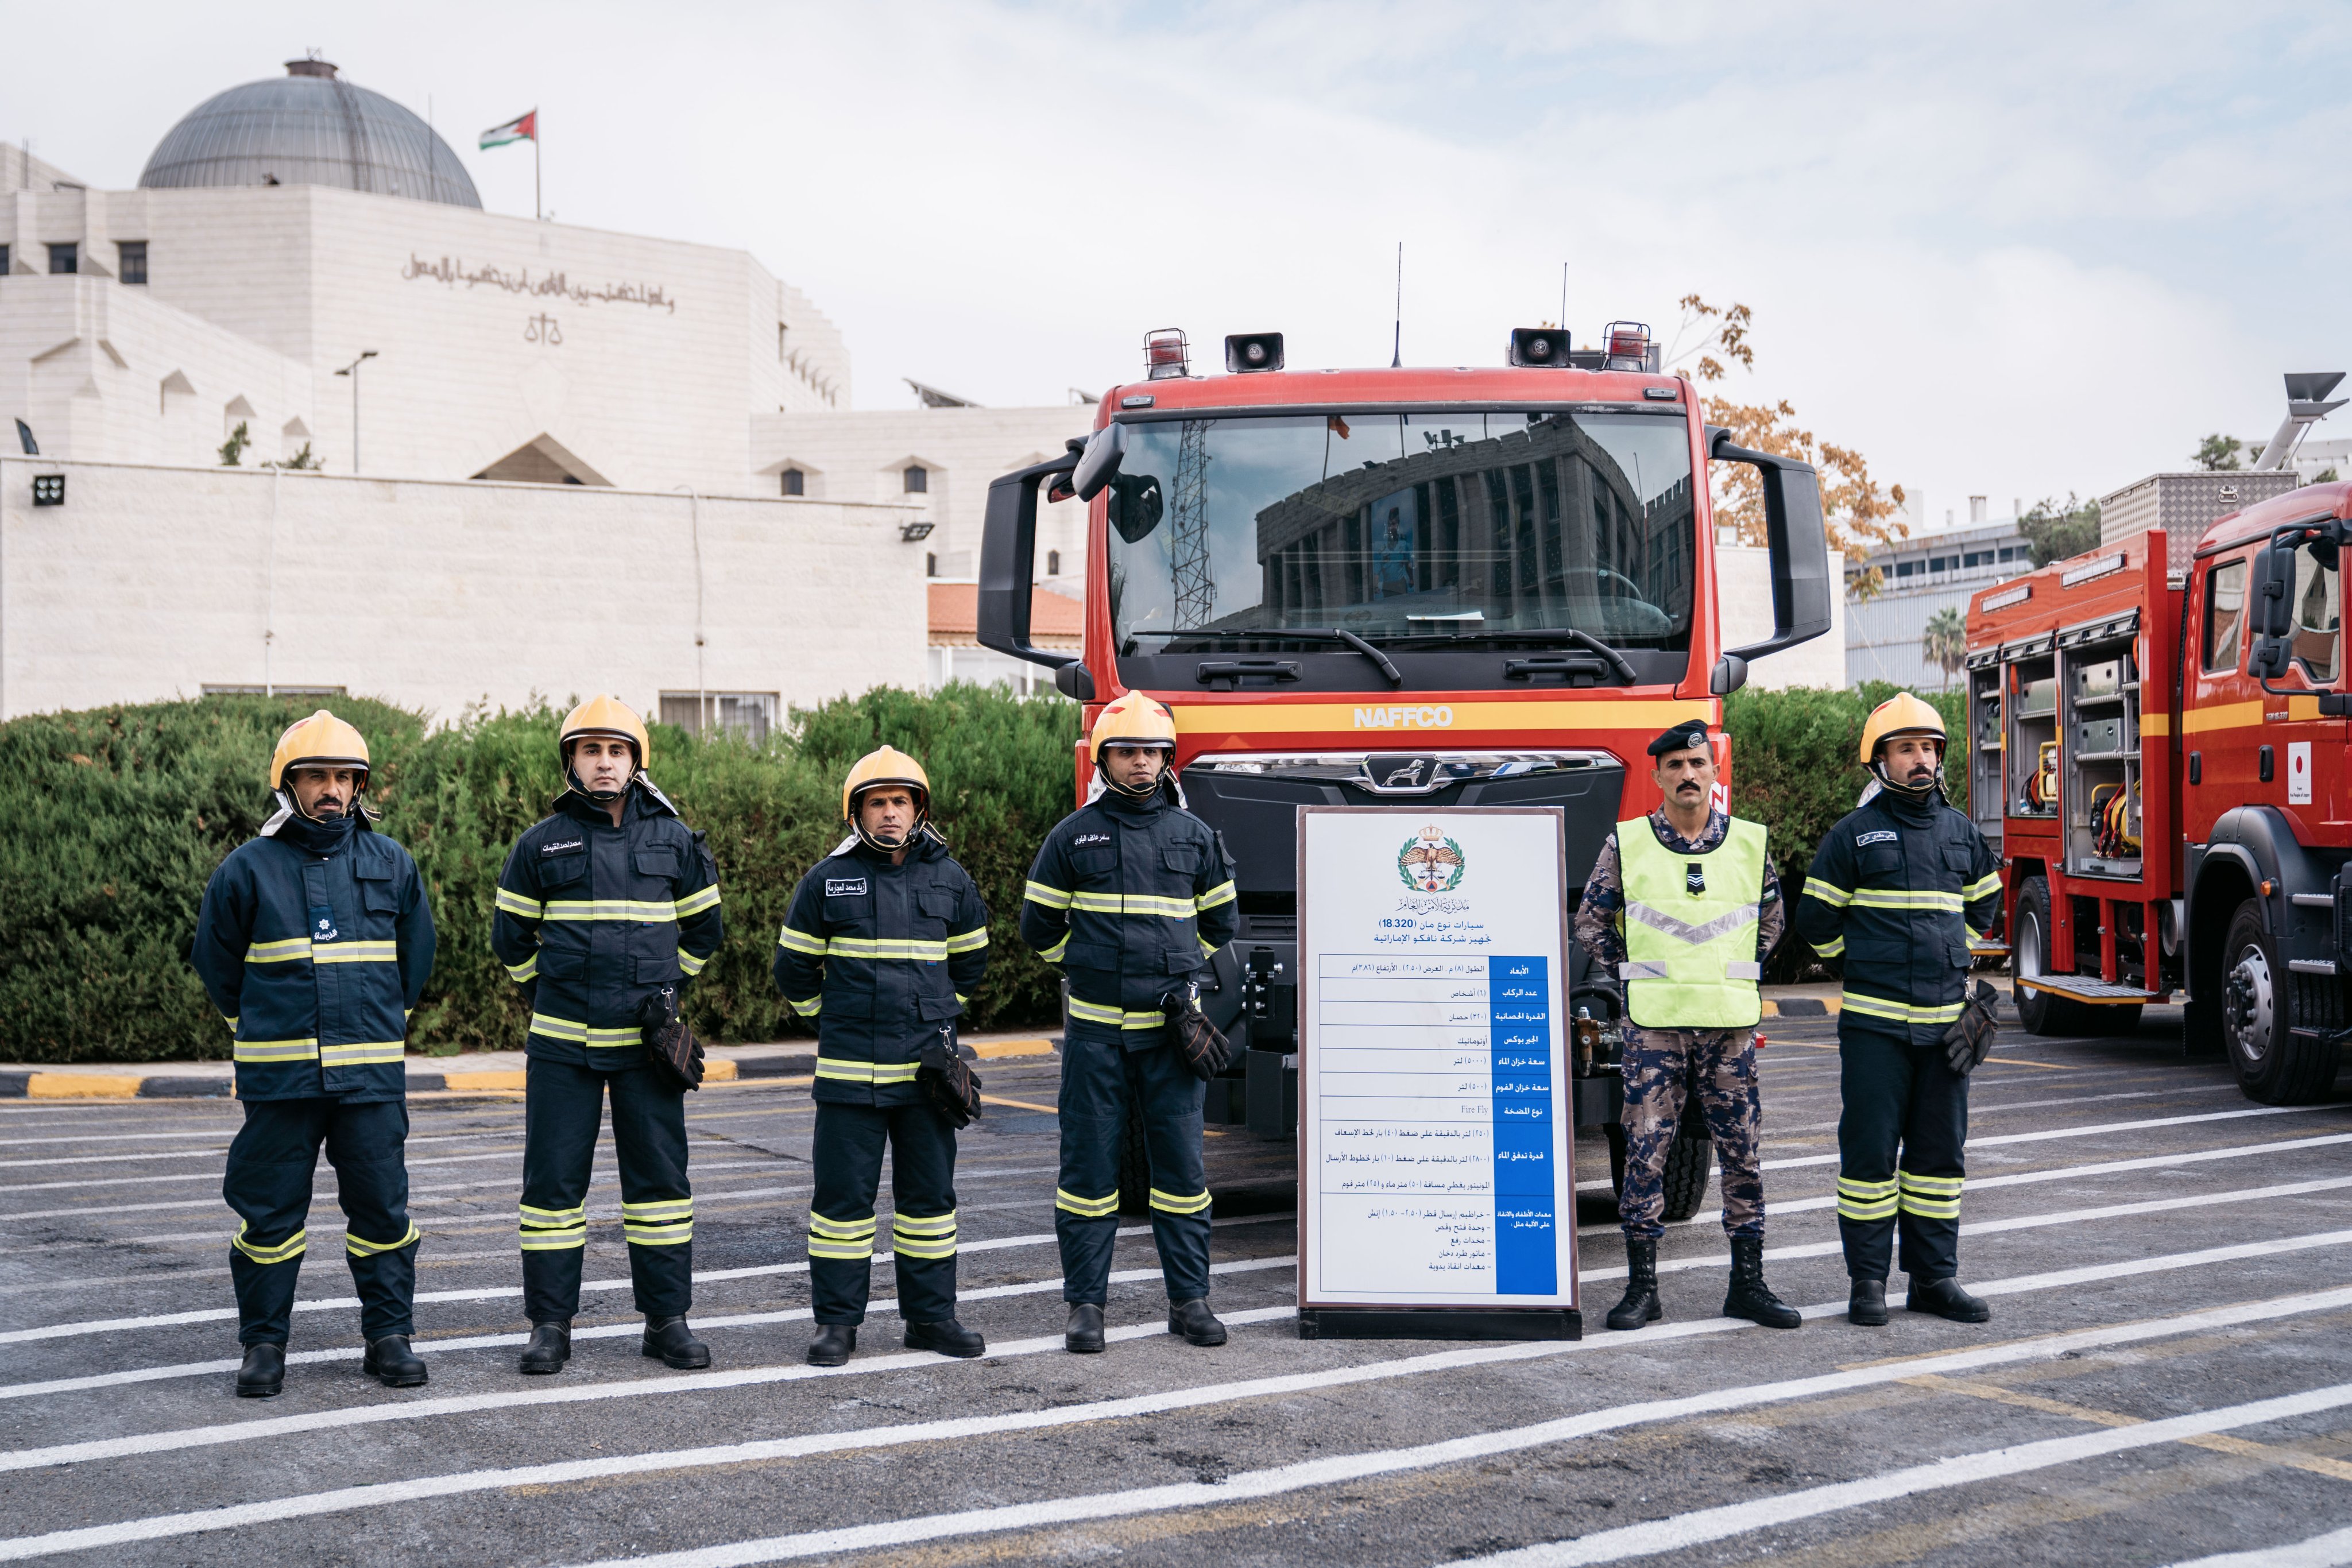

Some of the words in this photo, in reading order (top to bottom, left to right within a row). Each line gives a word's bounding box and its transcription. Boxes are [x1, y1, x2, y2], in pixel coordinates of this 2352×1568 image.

[1354, 706, 1453, 728] NAFFCO
[1379, 919, 1417, 929] (18.320)
[1420, 920, 1434, 930] مان
[1437, 922, 1451, 931] نوع
[1454, 921, 1484, 930] سيارات
[1414, 935, 1437, 944] نافكو
[1440, 934, 1466, 944] شركة
[1469, 934, 1492, 944] تجهيز
[1423, 965, 1443, 974] العرض
[1465, 965, 1484, 974] الطول
[1510, 965, 1529, 976] الأبعاد
[1450, 988, 1475, 998] أشخاص
[1502, 988, 1523, 998] الركاب
[1449, 1014, 1469, 1022] حصان
[1495, 1012, 1524, 1021] الحصانية
[1526, 1012, 1546, 1021] القدرة
[1503, 1035, 1523, 1045] بوكس
[1525, 1035, 1538, 1045] الجير
[1453, 1057, 1463, 1066] لتر
[1498, 1057, 1510, 1066] الماء
[1511, 1058, 1526, 1067] خزان
[1457, 1083, 1467, 1092] لتر
[1496, 1083, 1514, 1093] الفوم
[1515, 1084, 1530, 1093] خزان
[1461, 1105, 1475, 1113] Fire
[1478, 1105, 1488, 1115] Fly
[1531, 1109, 1543, 1118] نوع
[1420, 1129, 1433, 1139] على
[1435, 1130, 1461, 1139] بالدقيقة
[1461, 1130, 1471, 1139] لتر
[1417, 1155, 1429, 1164] على
[1498, 1151, 1509, 1159] الماء
[1511, 1152, 1528, 1161] تدفق
[1529, 1151, 1544, 1161] قدرة
[1432, 1156, 1457, 1164] بالدقيقة
[1459, 1156, 1468, 1164] لتر
[1342, 1180, 1353, 1190] فوم
[1354, 1181, 1365, 1189] متر
[1422, 1210, 1437, 1219] قطر
[1459, 1210, 1484, 1219] خراطيم
[1435, 1224, 1452, 1232] وقص
[1453, 1224, 1467, 1234] فتح
[1468, 1224, 1484, 1233] وحدة
[1513, 1221, 1525, 1229] مثل
[1450, 1237, 1461, 1246] رفع
[1438, 1249, 1453, 1259] دخان
[1455, 1249, 1468, 1259] طرد
[1469, 1250, 1485, 1259] ماتور
[1429, 1262, 1445, 1272] يدوية
